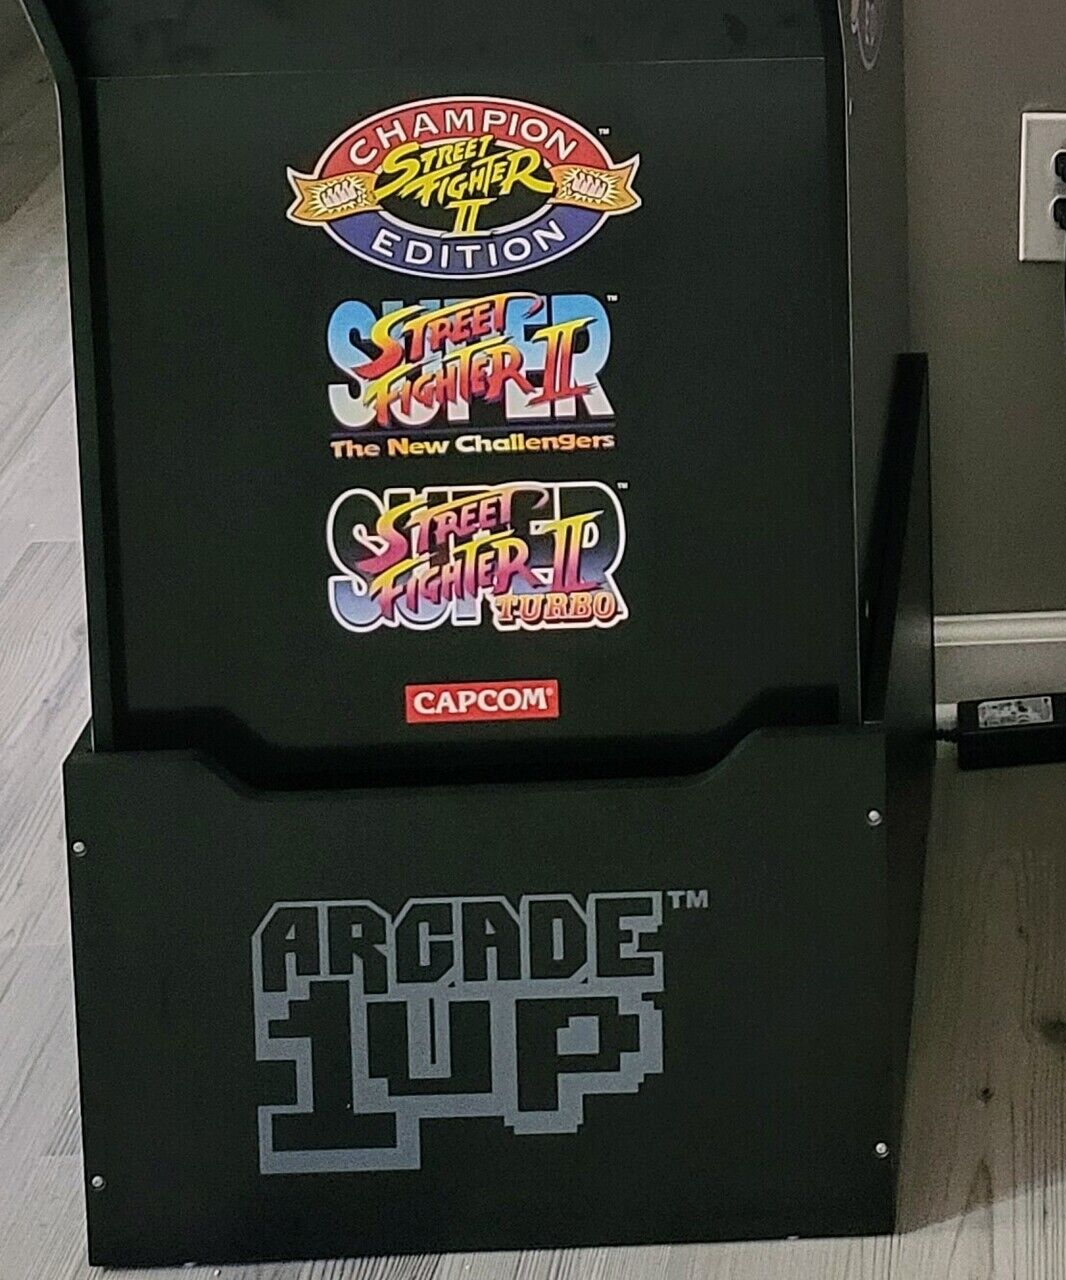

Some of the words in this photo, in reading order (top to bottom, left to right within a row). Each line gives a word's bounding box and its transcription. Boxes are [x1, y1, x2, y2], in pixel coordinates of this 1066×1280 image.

[349, 109, 578, 166] CHAMPION
[373, 135, 495, 202] STREET
[412, 147, 554, 207] FIGHTER
[371, 218, 568, 269] EDITION
[445, 198, 497, 238] II
[352, 291, 544, 380] STREET
[363, 335, 538, 427] FIGHTER
[524, 316, 599, 407] II
[331, 440, 381, 459] The
[388, 438, 450, 456] New
[455, 433, 616, 455] Challengers
[354, 482, 550, 574] STREET
[368, 528, 543, 621] FIGHTER
[540, 509, 605, 592] II
[496, 592, 618, 623] TURBO
[253, 891, 663, 998] ARCADE
